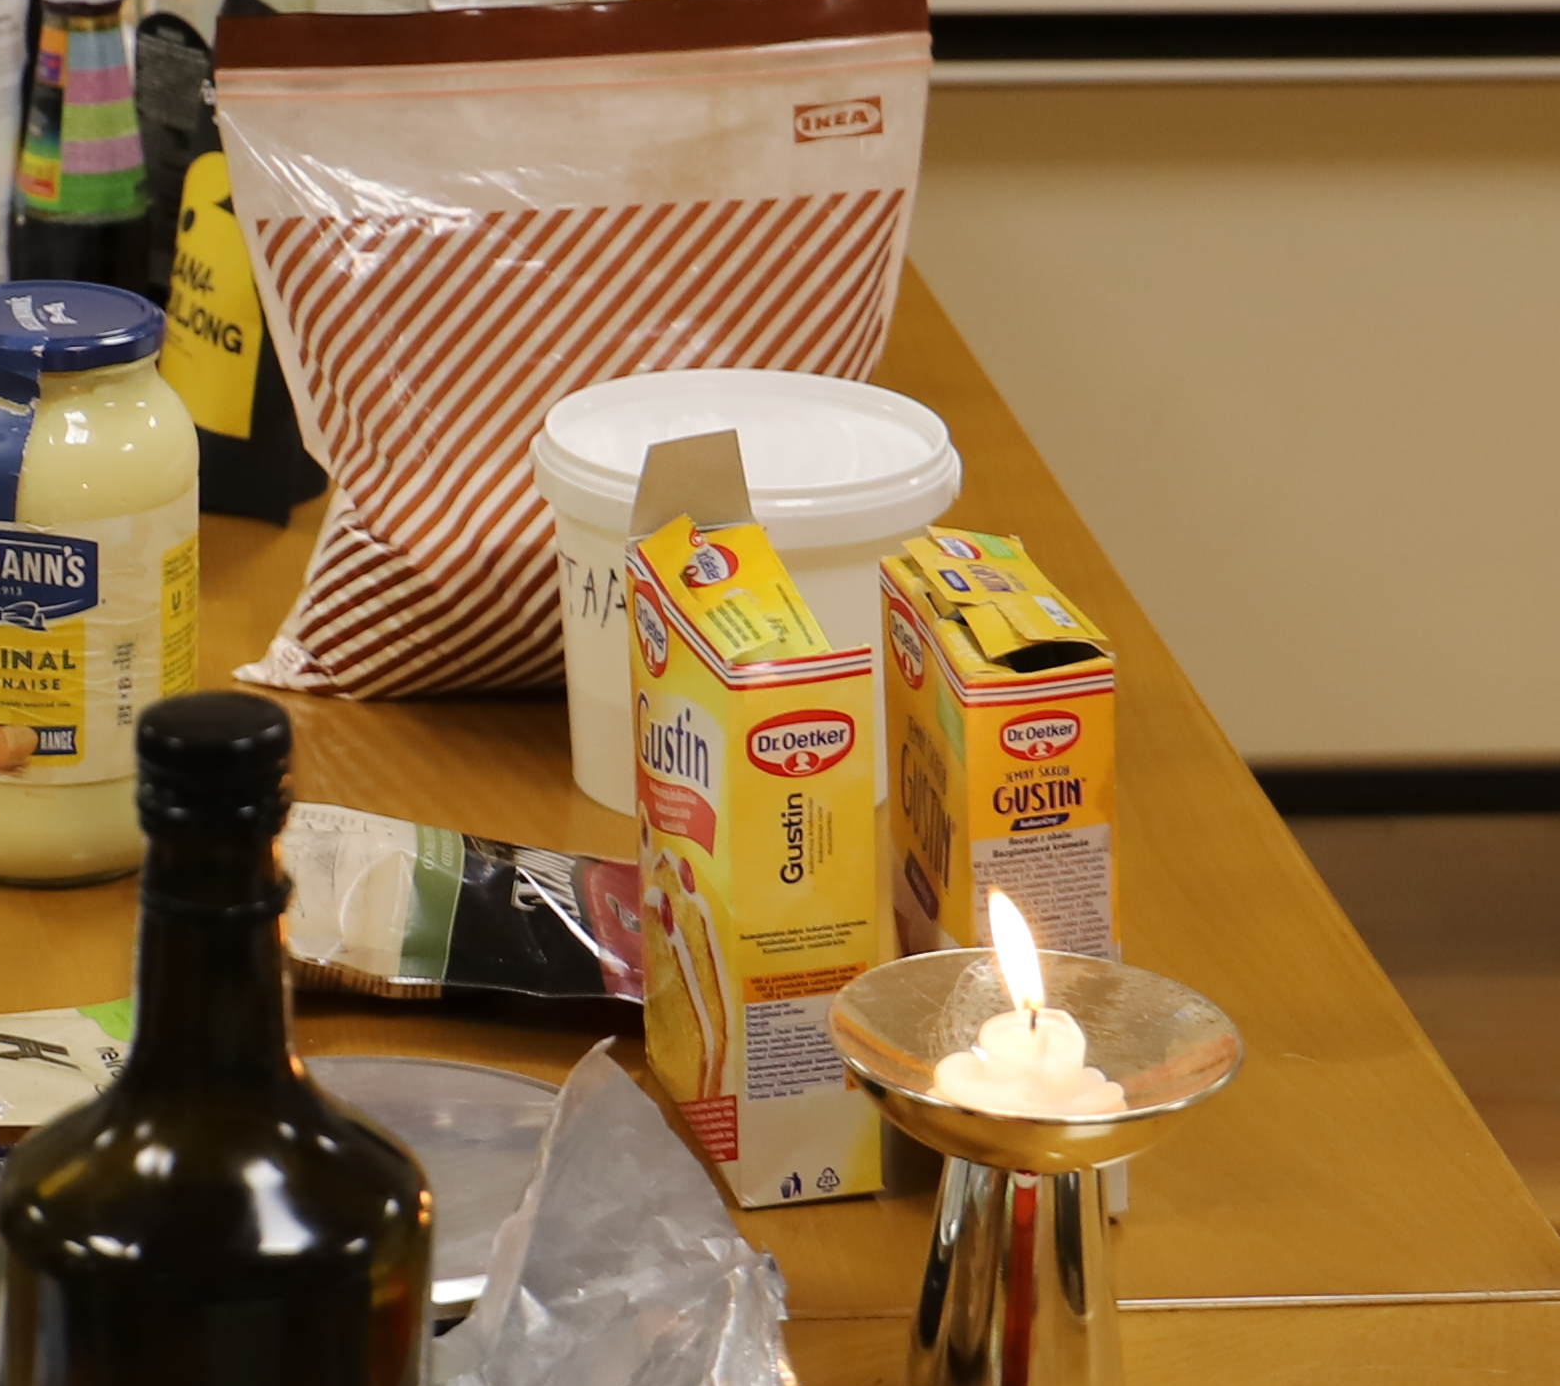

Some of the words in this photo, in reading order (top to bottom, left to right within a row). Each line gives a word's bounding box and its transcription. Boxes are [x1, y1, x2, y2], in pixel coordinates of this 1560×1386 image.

[39, 730, 75, 751] RANGE
[637, 689, 710, 790] Gustin
[782, 727, 847, 750] Oetker
[1026, 722, 1075, 740] Oetker
[993, 778, 1082, 815] GUSTIN
[780, 791, 804, 885] Gustin
